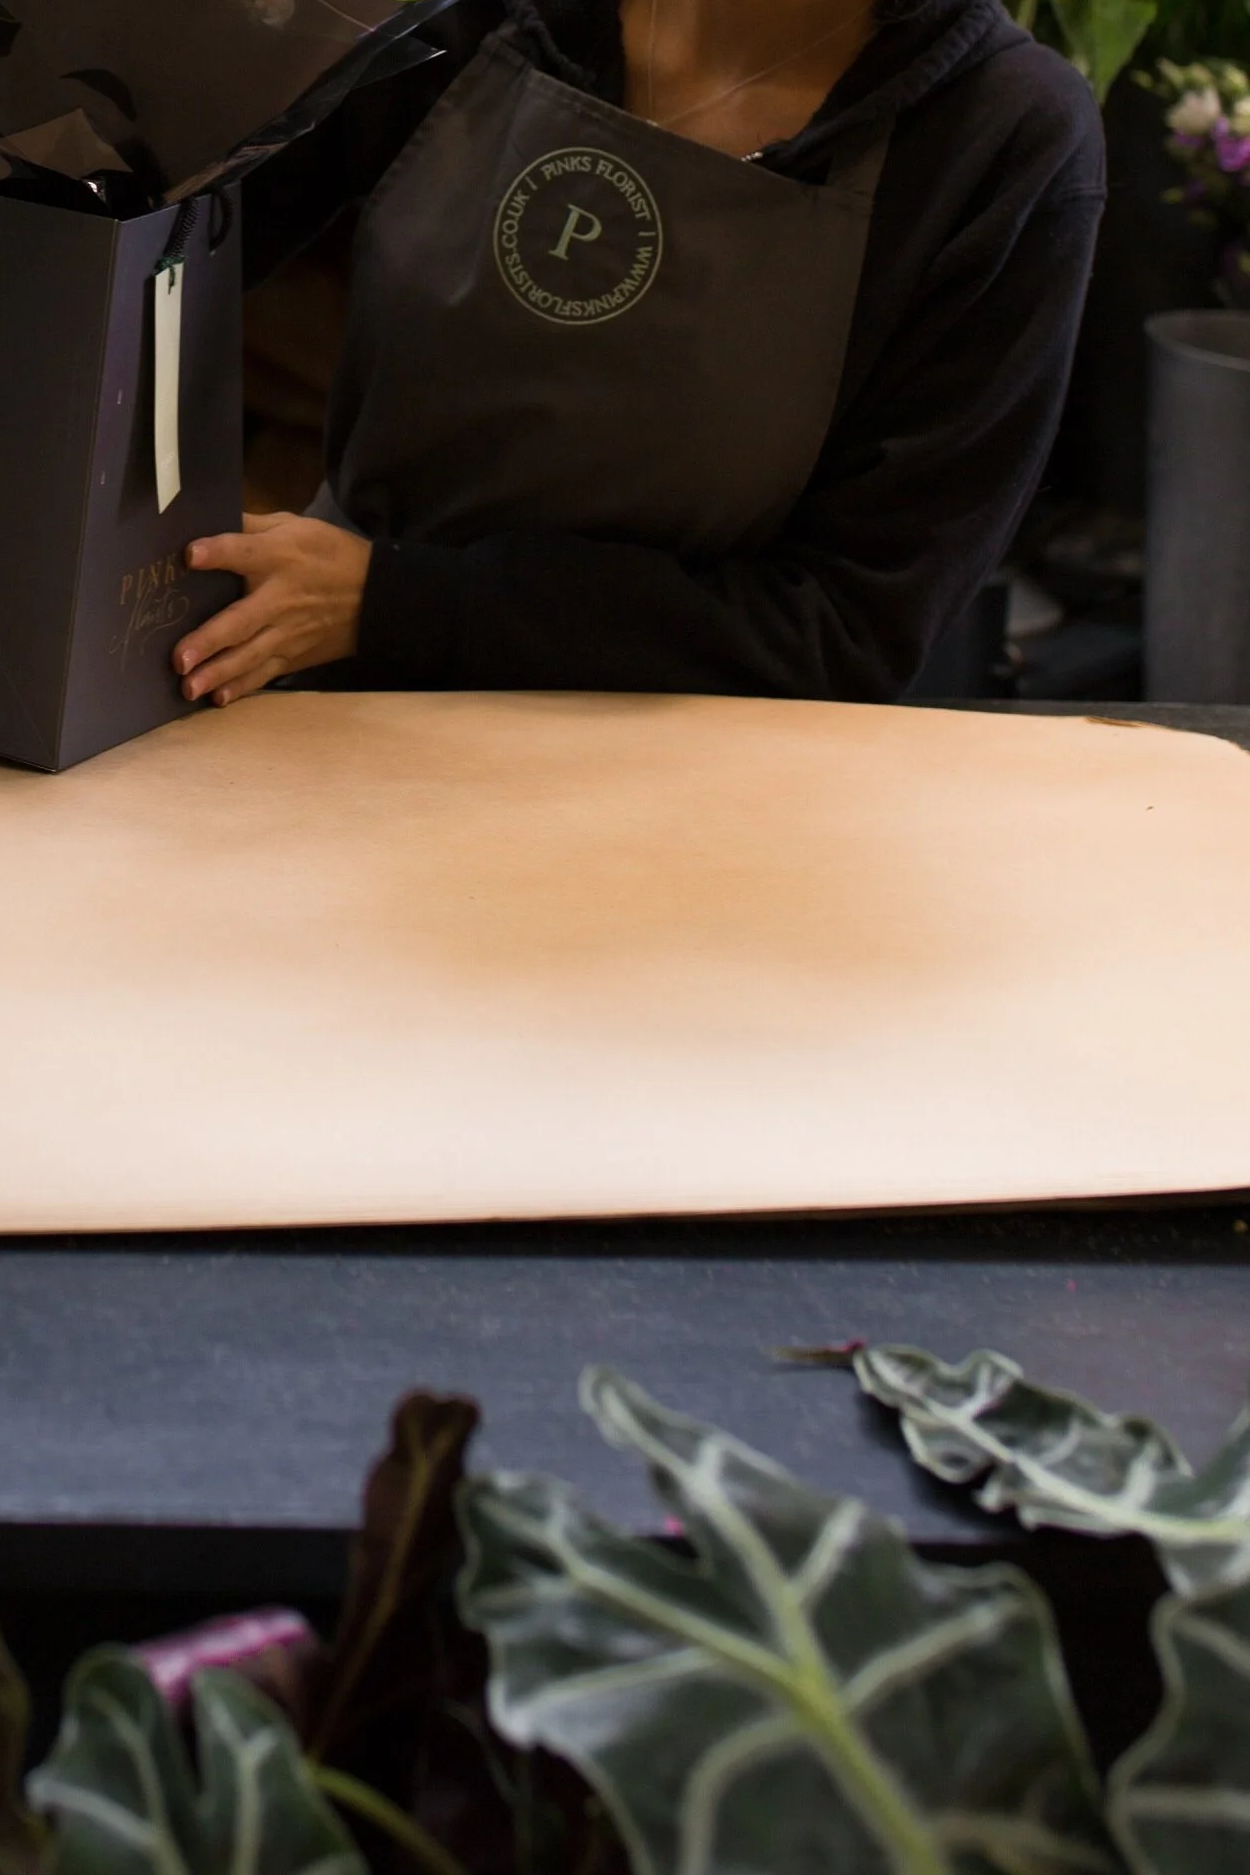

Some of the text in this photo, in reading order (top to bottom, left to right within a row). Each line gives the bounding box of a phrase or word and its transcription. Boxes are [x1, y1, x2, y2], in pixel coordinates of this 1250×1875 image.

[539, 156, 592, 181] PINKS
[595, 159, 652, 221] FLORIST
[547, 202, 603, 261] P
[118, 552, 182, 606] PINK
